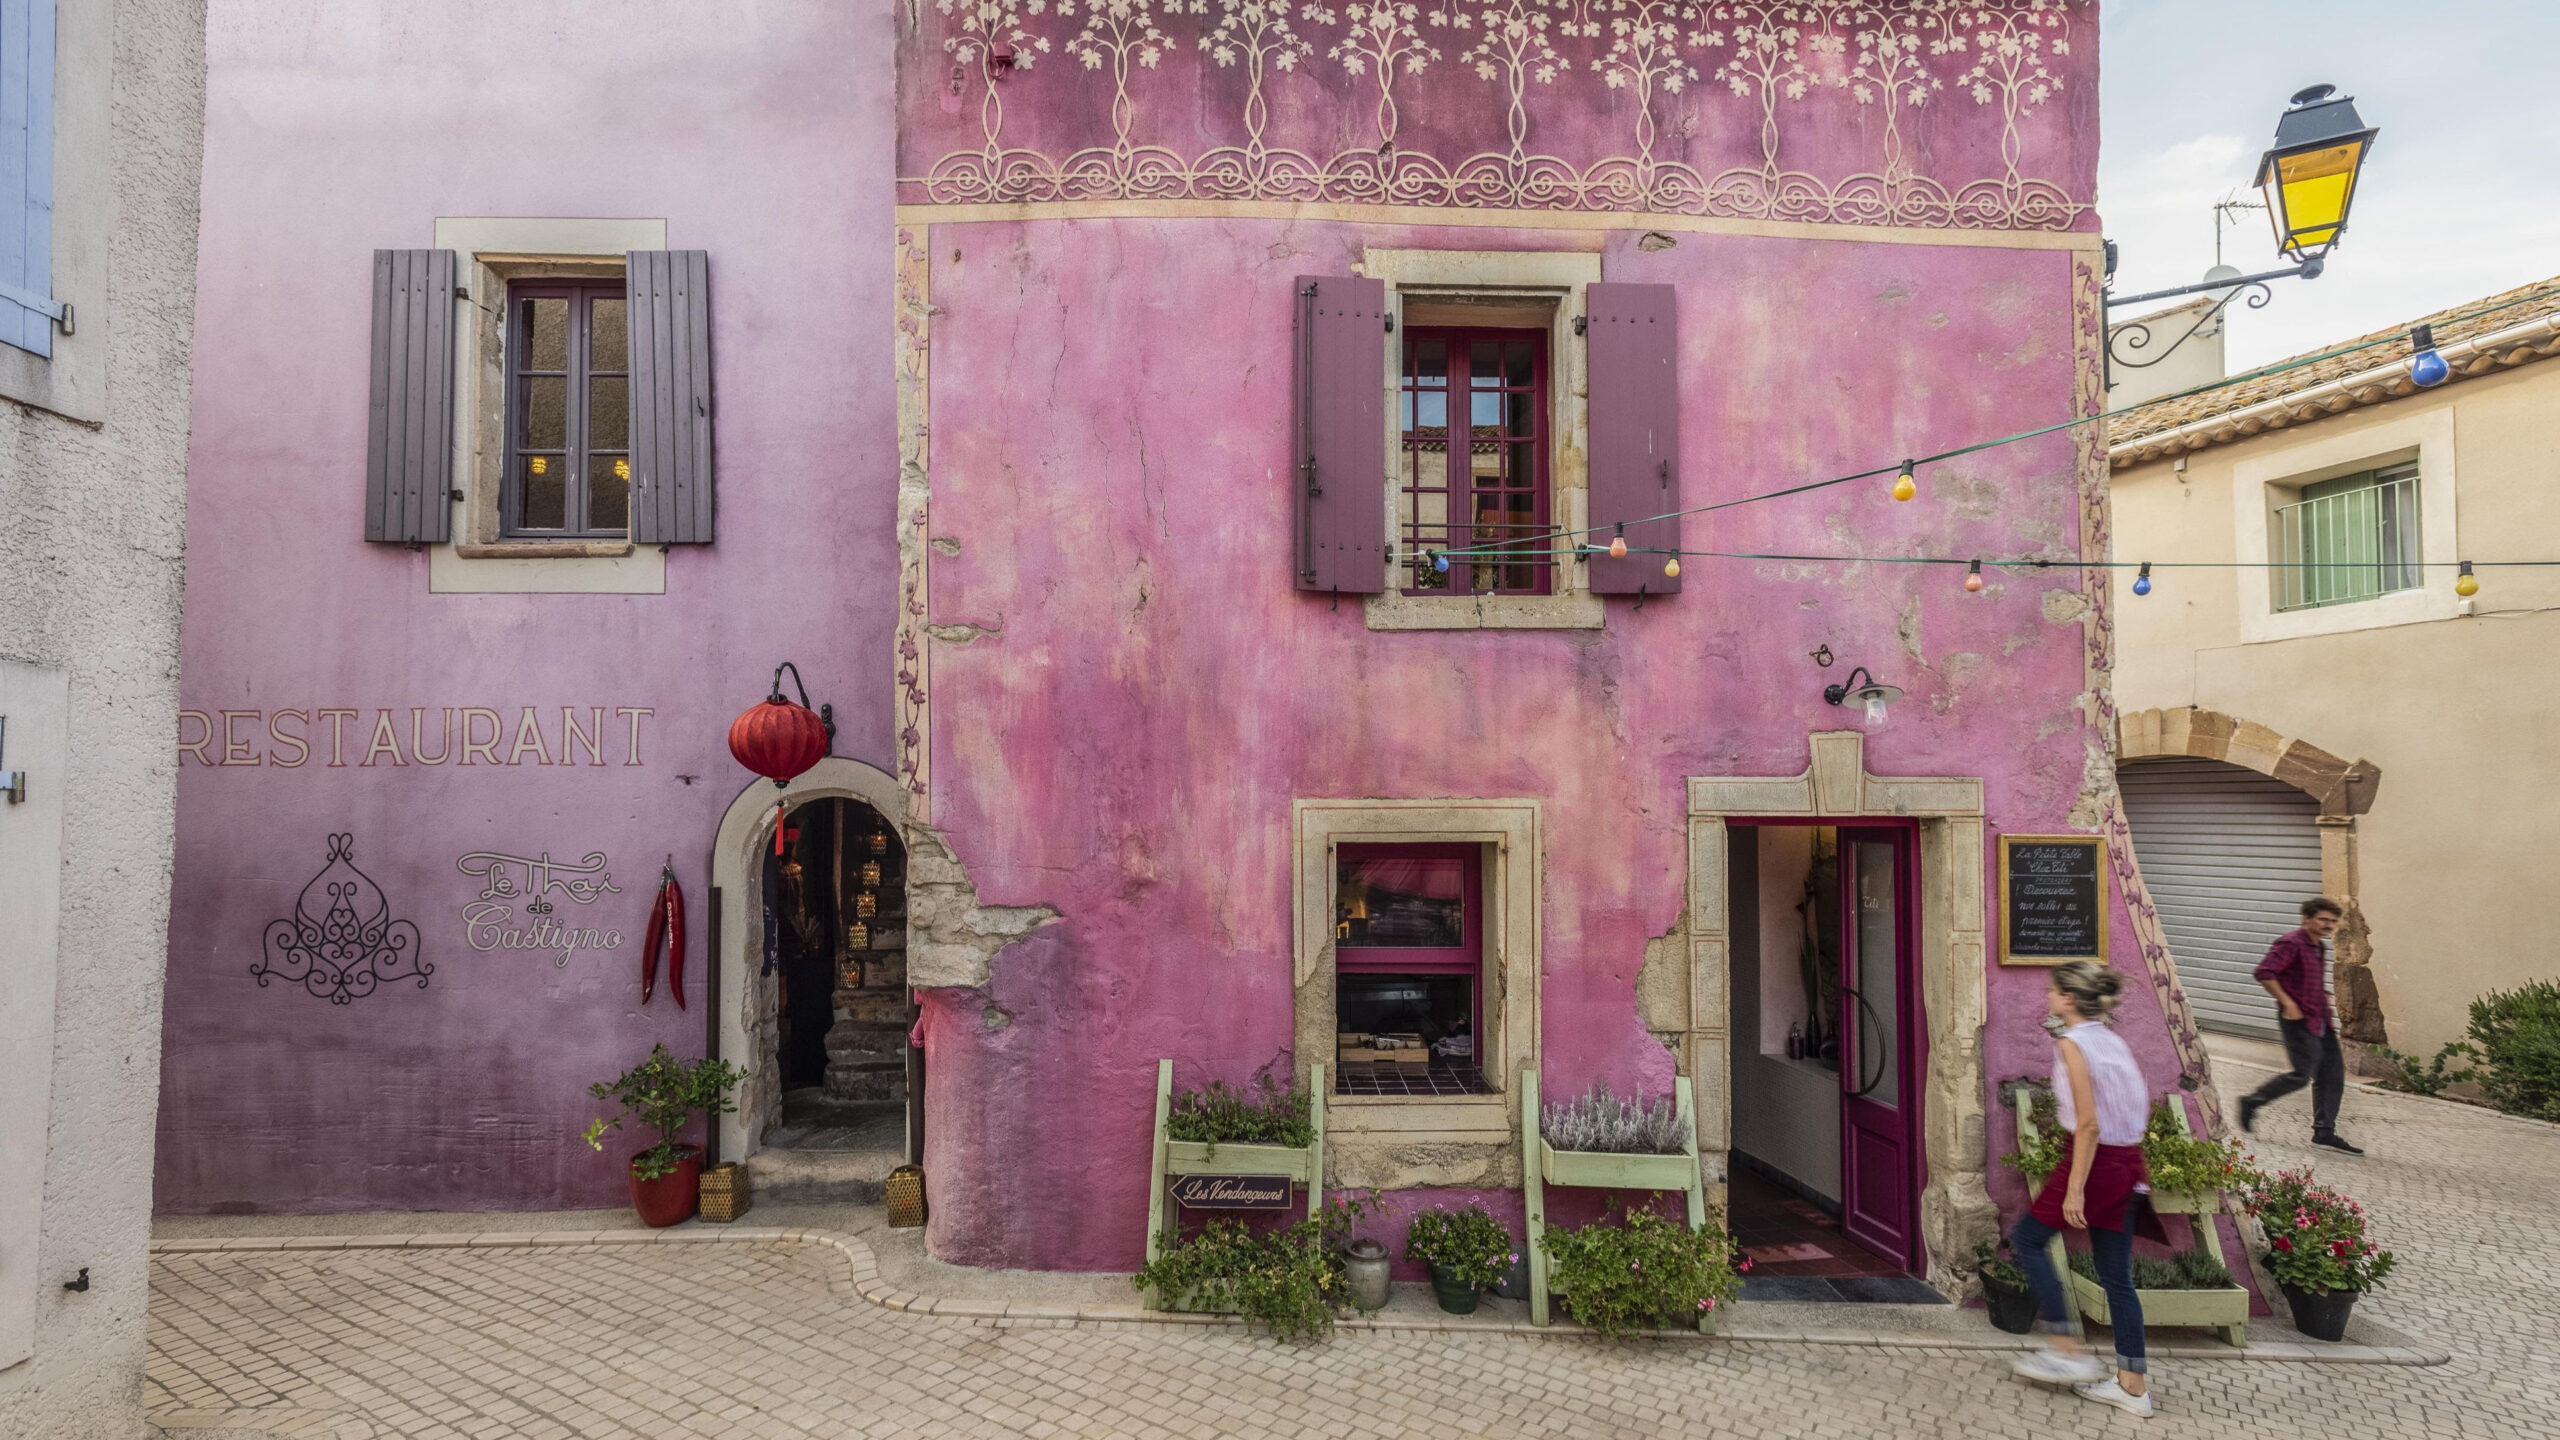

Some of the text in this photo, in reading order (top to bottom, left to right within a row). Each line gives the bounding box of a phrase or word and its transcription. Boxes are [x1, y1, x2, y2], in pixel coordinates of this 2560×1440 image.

[178, 706, 655, 768] RESTAURANT
[2032, 847, 2057, 860] Petite
[456, 851, 622, 904] Le Thai
[526, 895, 553, 914] de
[461, 901, 625, 968] Castigno
[1183, 1179, 1284, 1204] Les Vendangeurs
